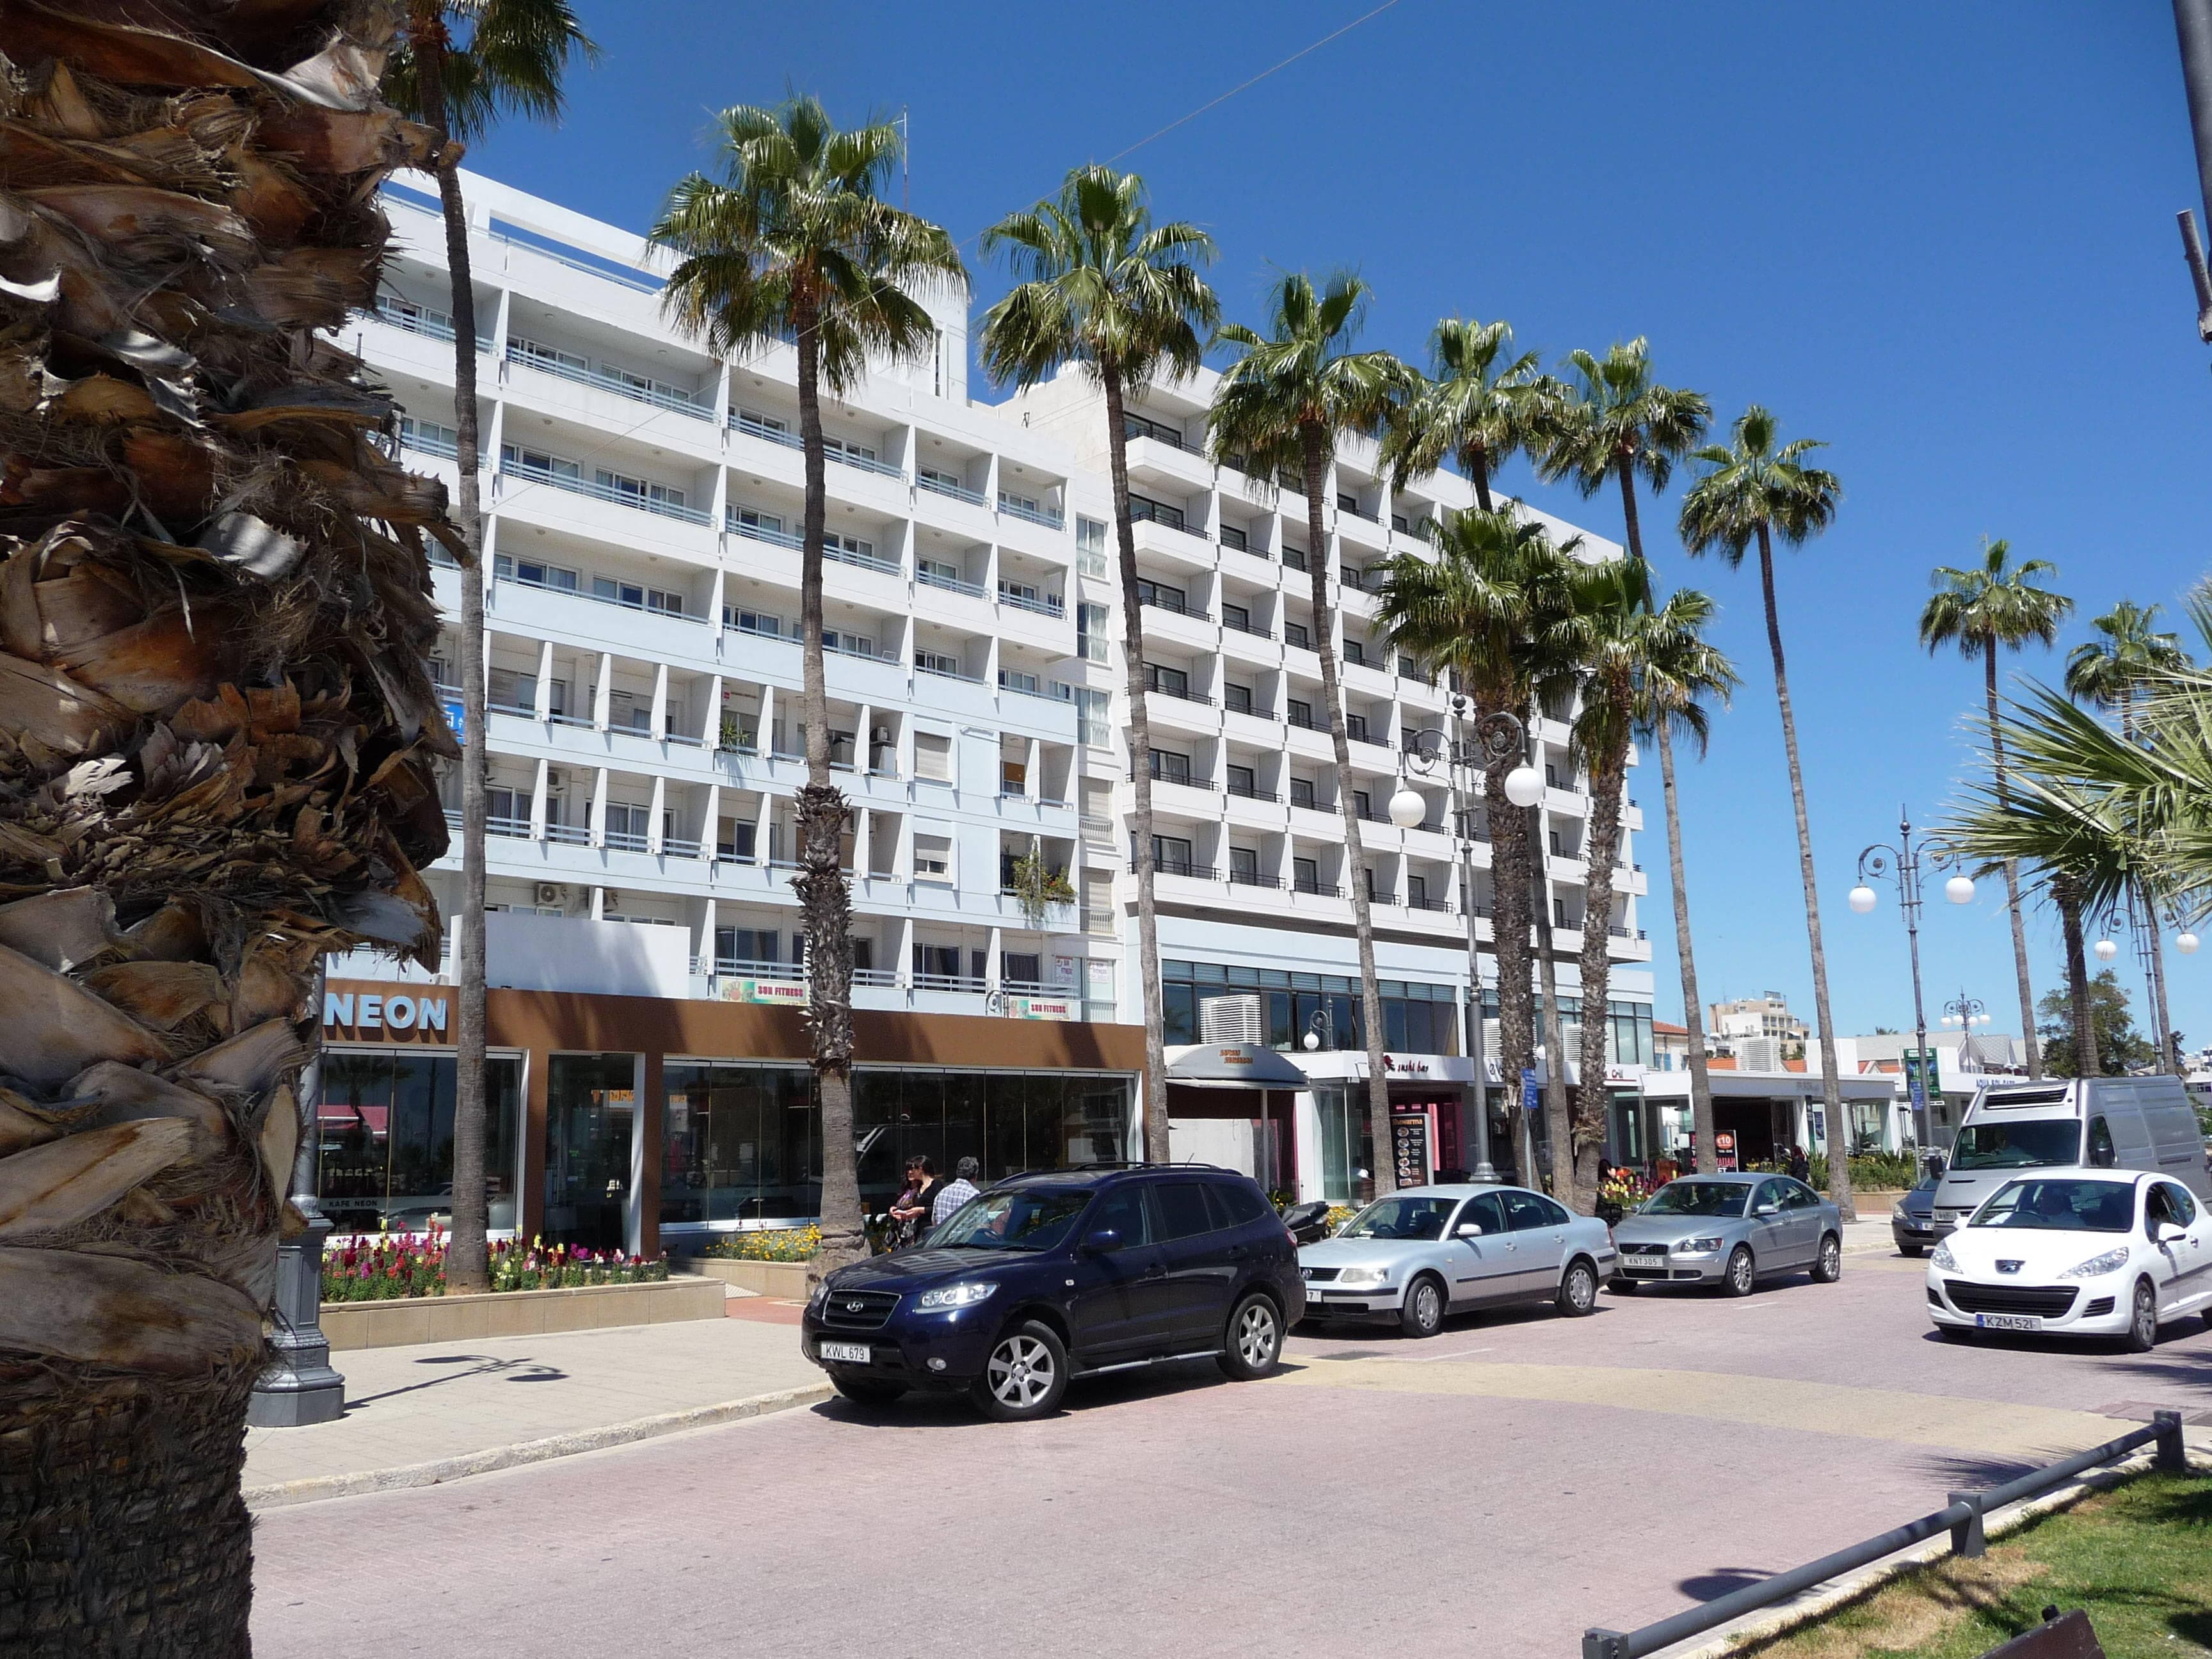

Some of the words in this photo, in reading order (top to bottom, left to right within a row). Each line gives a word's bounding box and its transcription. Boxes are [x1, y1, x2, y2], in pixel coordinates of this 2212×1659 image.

[775, 986, 804, 997] FITNESS
[323, 993, 446, 1030] NEON
[1044, 1004, 1066, 1014] FITNESS
[1397, 1060, 1415, 1073] sushi
[1417, 1061, 1429, 1073] bar
[1716, 1157, 1736, 1168] TALIAN
[1986, 1317, 2013, 1328] KZM
[2015, 1318, 2033, 1329] 521
[826, 1345, 846, 1358] KWL
[849, 1347, 865, 1360] 679
